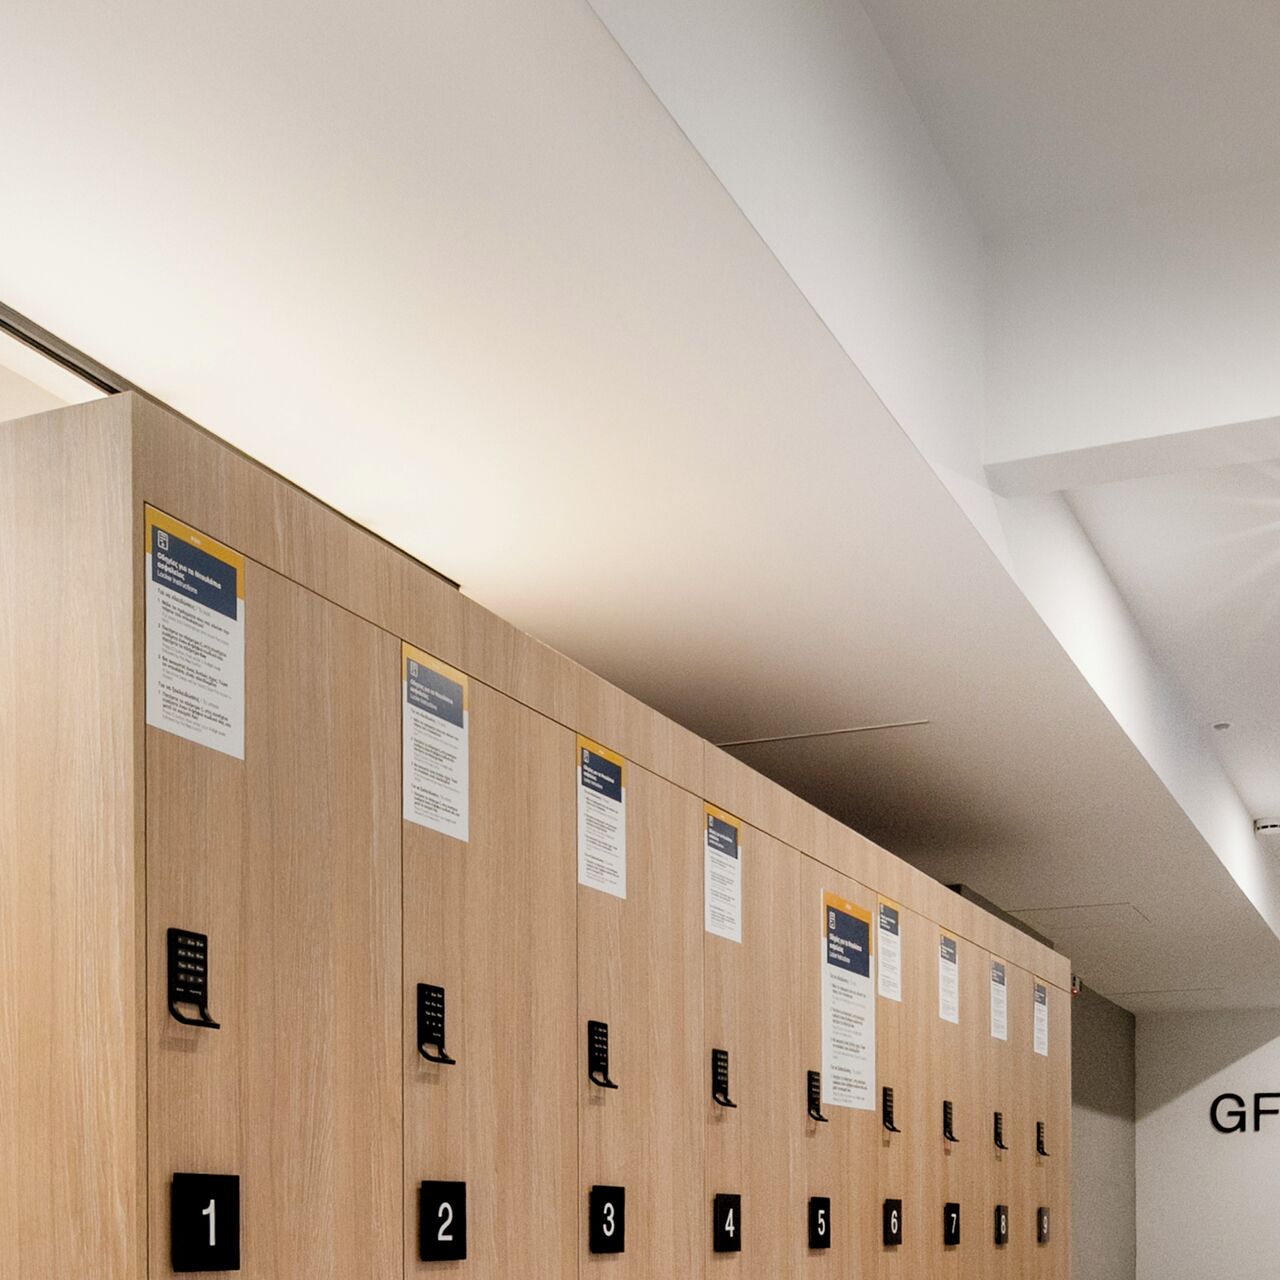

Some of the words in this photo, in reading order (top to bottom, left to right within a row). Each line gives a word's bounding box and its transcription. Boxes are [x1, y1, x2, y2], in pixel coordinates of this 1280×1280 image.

[202, 1199, 216, 1246] 1
[437, 1202, 453, 1241] 2
[602, 1202, 615, 1237] 3
[724, 1208, 735, 1238] 4
[818, 1210, 825, 1235] 5
[891, 1210, 898, 1234] 6
[951, 1213, 956, 1233] 7
[1001, 1214, 1006, 1234] 8
[1042, 1215, 1048, 1233] 9
